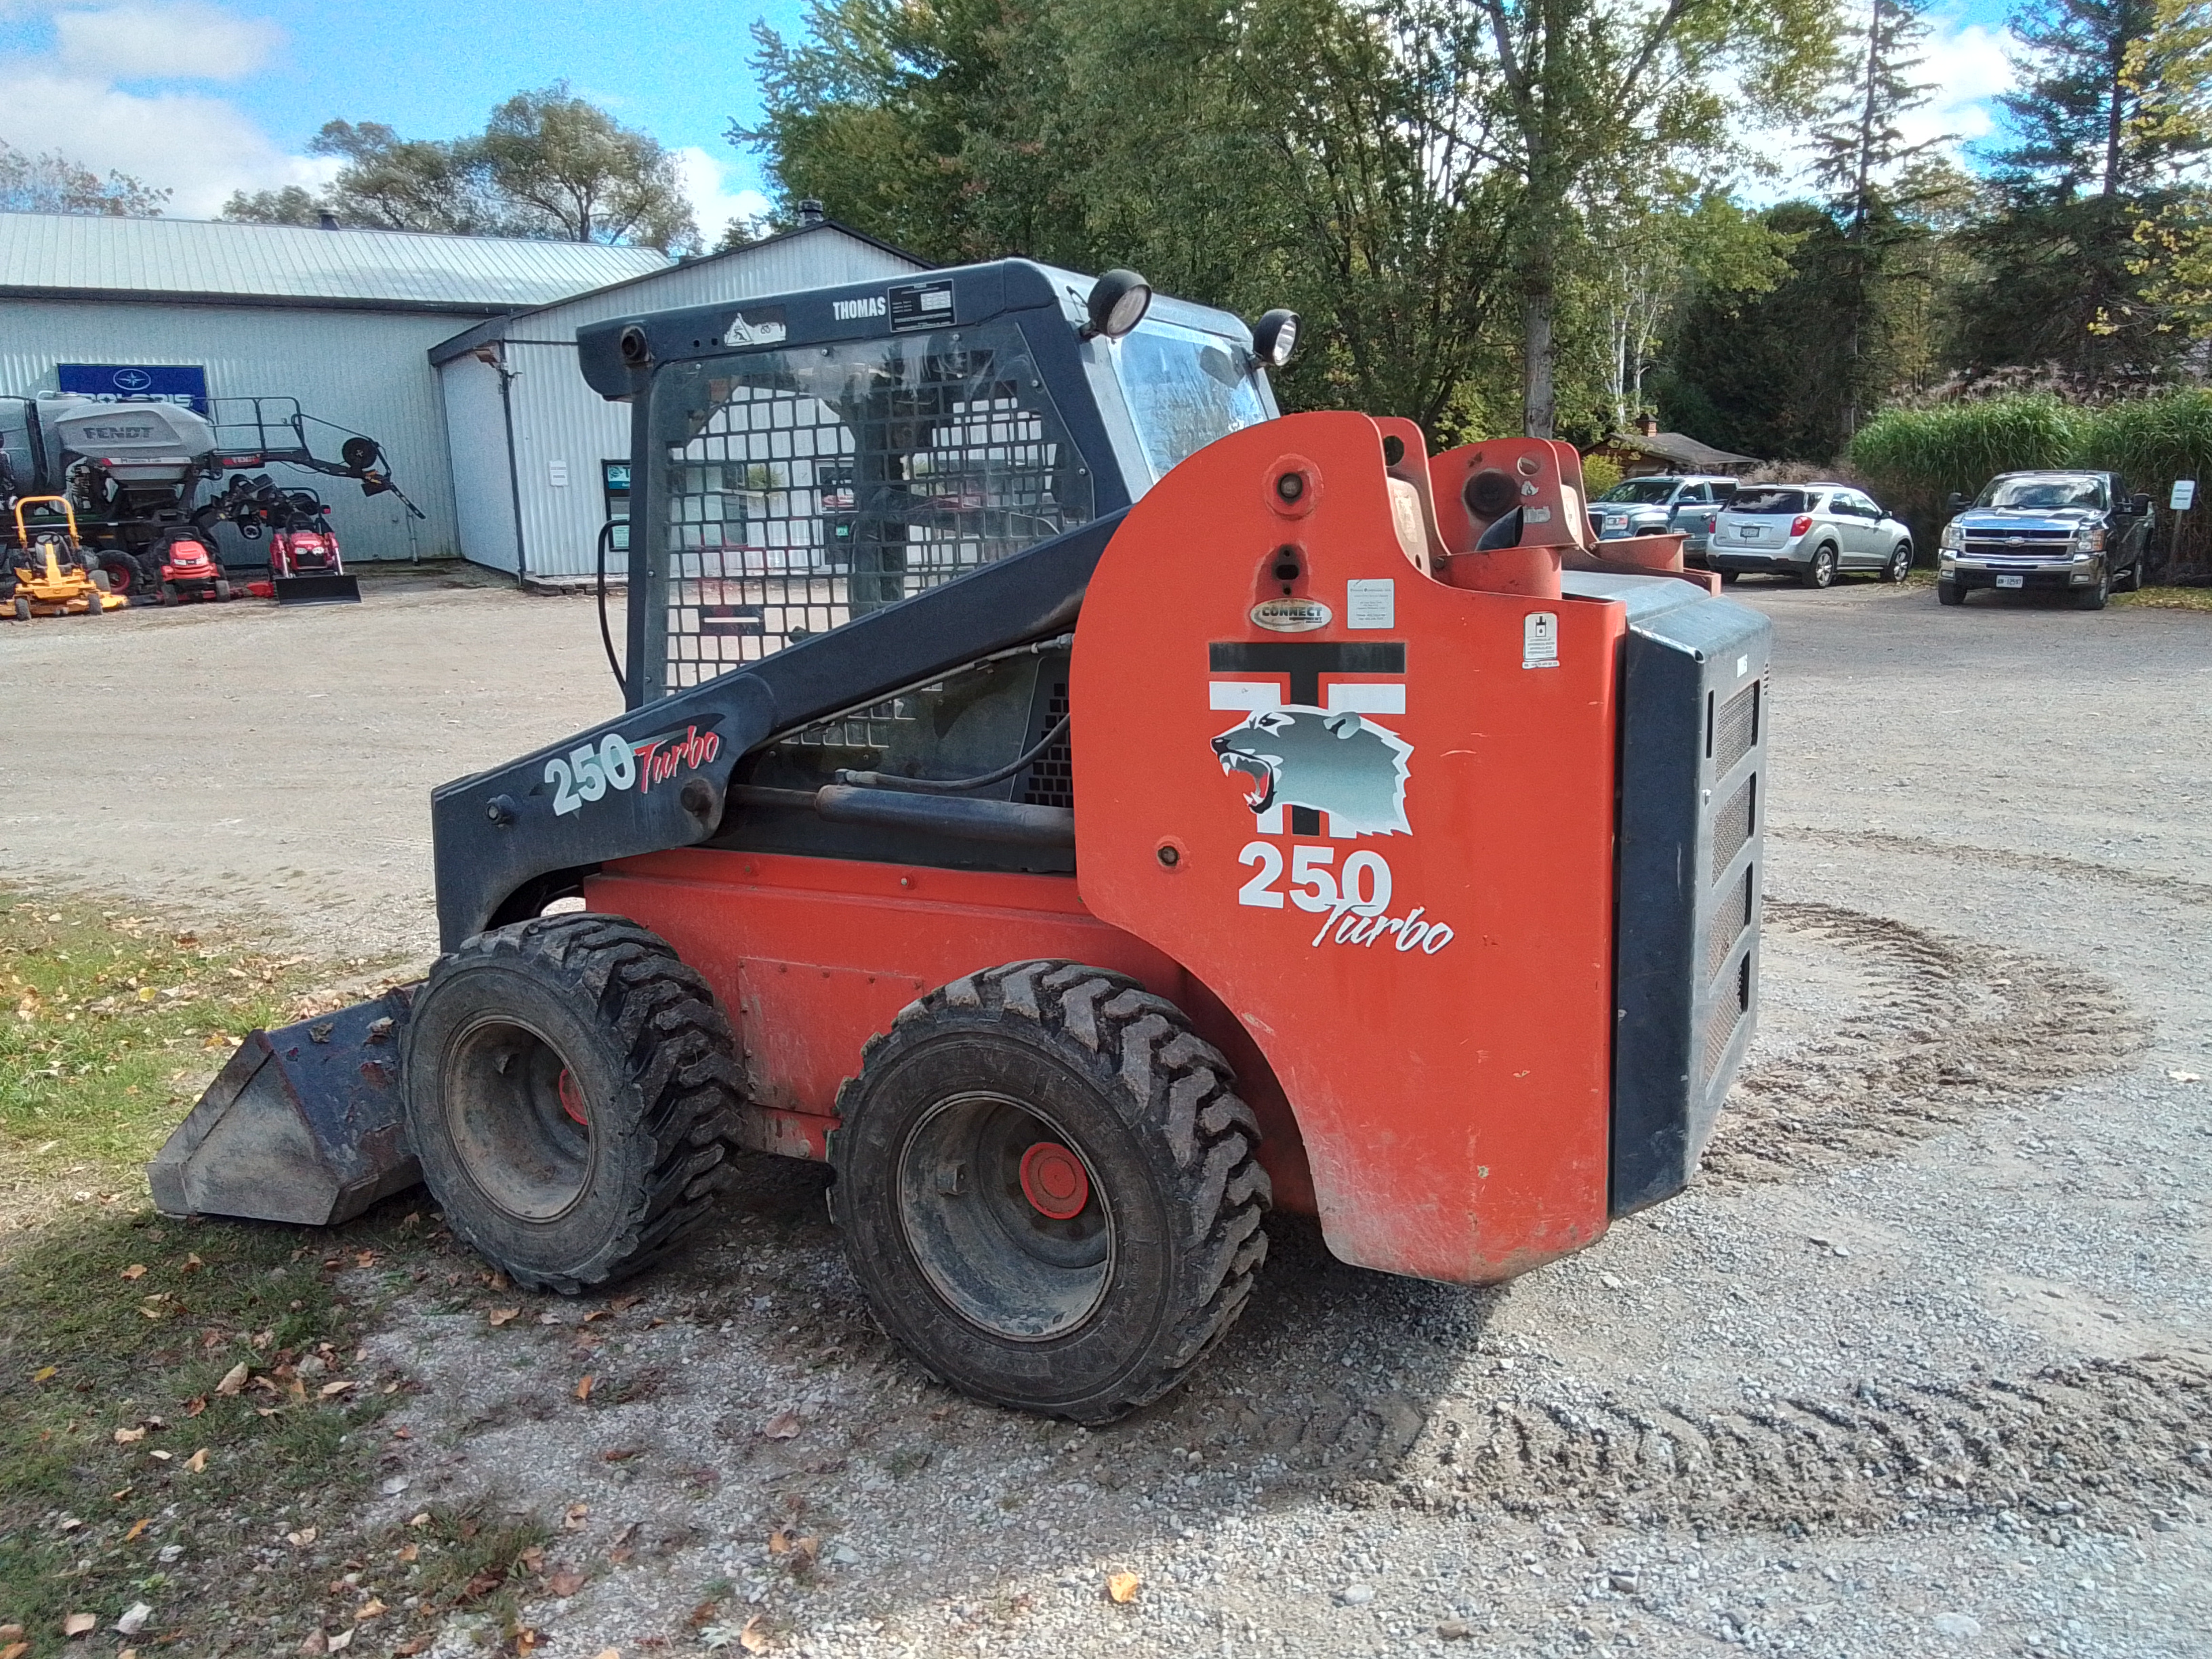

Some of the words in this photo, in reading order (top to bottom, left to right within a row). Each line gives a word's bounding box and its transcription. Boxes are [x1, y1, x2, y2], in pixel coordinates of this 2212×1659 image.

[832, 295, 886, 321] THOMAS
[83, 426, 155, 440] FENDT
[1261, 607, 1323, 617] CONNECT
[544, 733, 636, 817] 250
[634, 725, 719, 794] Turbo
[1238, 840, 1393, 918] 250
[1312, 903, 1455, 955] Turbo
